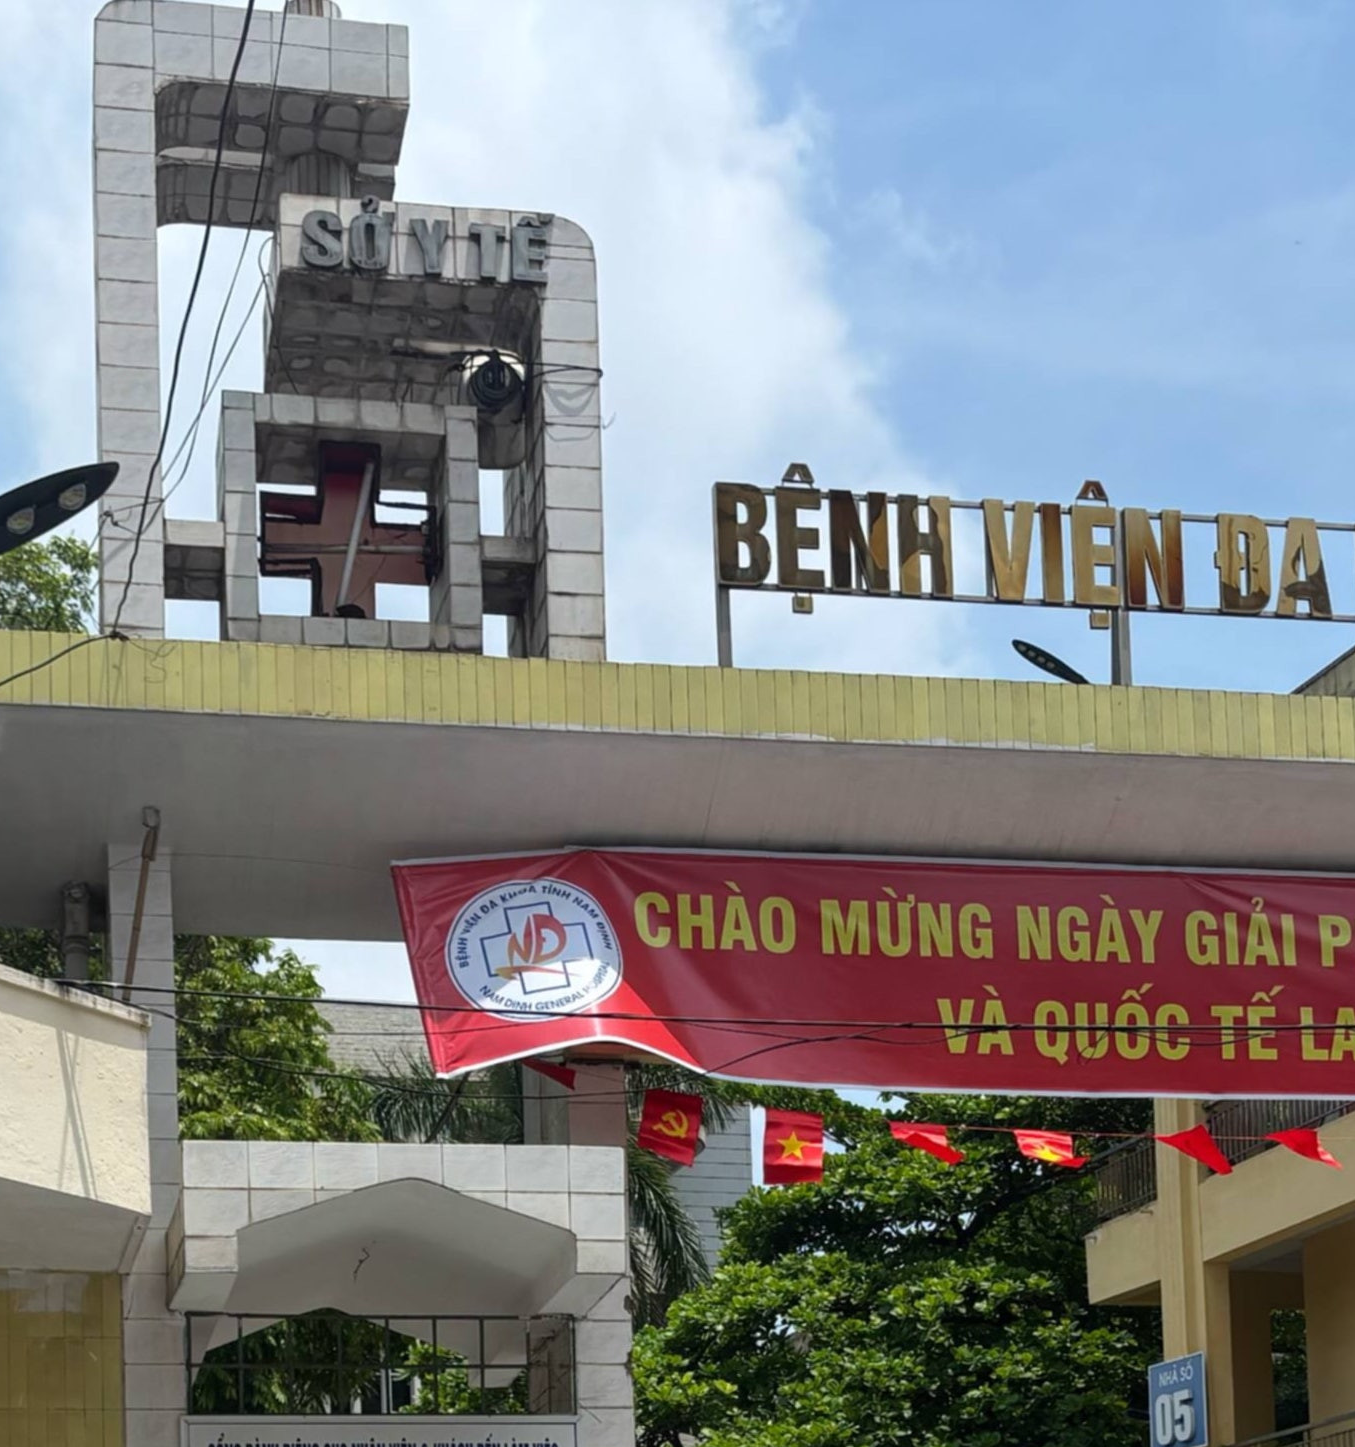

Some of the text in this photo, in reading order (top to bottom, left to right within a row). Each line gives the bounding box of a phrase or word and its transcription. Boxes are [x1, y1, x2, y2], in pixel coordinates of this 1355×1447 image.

[301, 195, 555, 282] SỞ Y TẾ
[713, 462, 951, 614] BỆNH
[982, 480, 1185, 629] VIỆN
[1215, 512, 1332, 619] ĐA
[455, 937, 470, 969] BỆNH
[572, 896, 599, 919] NAM
[633, 881, 798, 955] CHÀO
[821, 885, 995, 960] MỪNG
[1018, 894, 1163, 965] NGÀY
[1185, 896, 1297, 967] GIẢI
[479, 984, 504, 1004] NAM
[504, 997, 532, 1011] DINH
[535, 991, 585, 1010] GENERAL
[936, 984, 1015, 1057] VÀ
[1033, 983, 1191, 1066] QUỐC
[1211, 985, 1286, 1061] TẾ
[1158, 1364, 1179, 1388] NHÀ
[1155, 1389, 1194, 1445] 05
